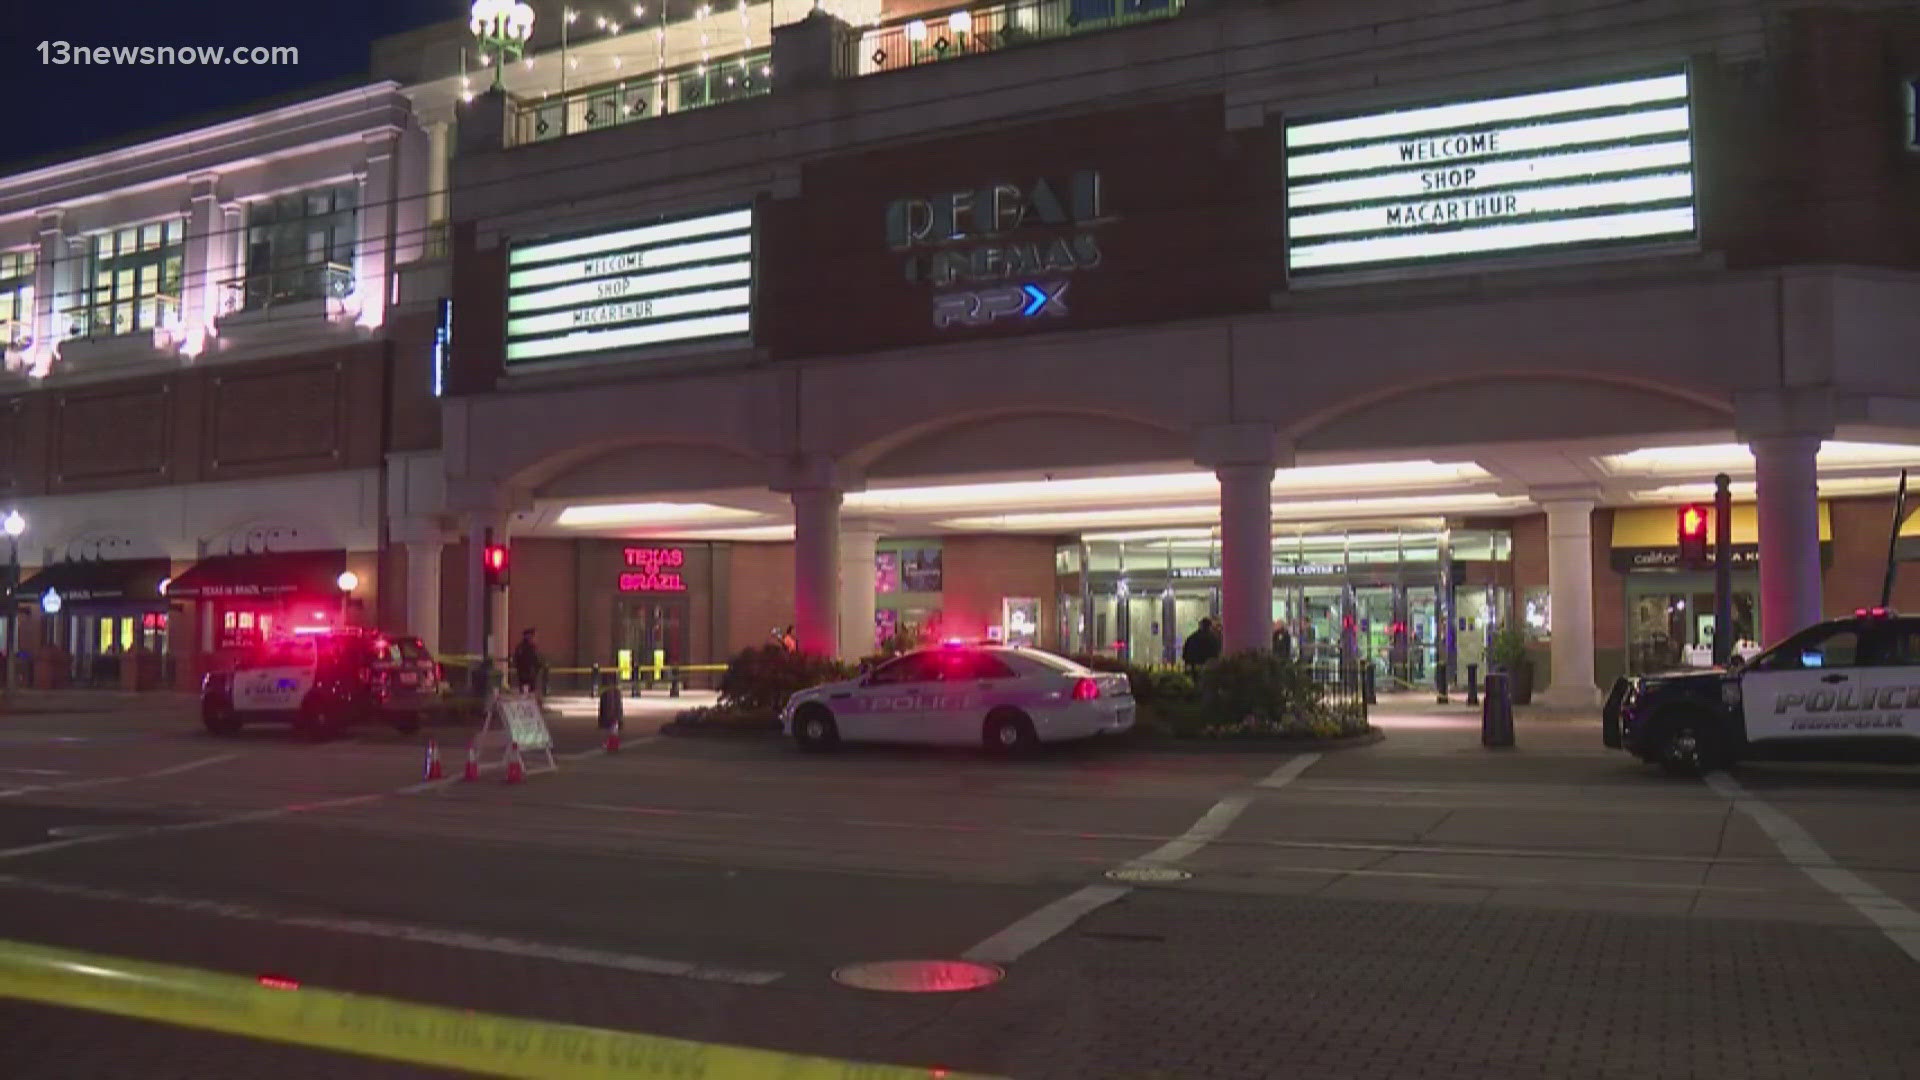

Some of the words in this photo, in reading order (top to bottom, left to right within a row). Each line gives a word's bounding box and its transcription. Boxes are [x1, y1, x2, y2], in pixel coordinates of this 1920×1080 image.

[1400, 132, 1499, 161] WELCOME
[1421, 167, 1476, 190] SHOP
[1386, 195, 1517, 225] MACARTHUR
[584, 251, 645, 275] WELCOME
[597, 276, 630, 299] SHOP
[573, 301, 653, 325] MACARTHUR
[624, 547, 683, 567] TEXAS
[619, 573, 687, 591] BRAZIL
